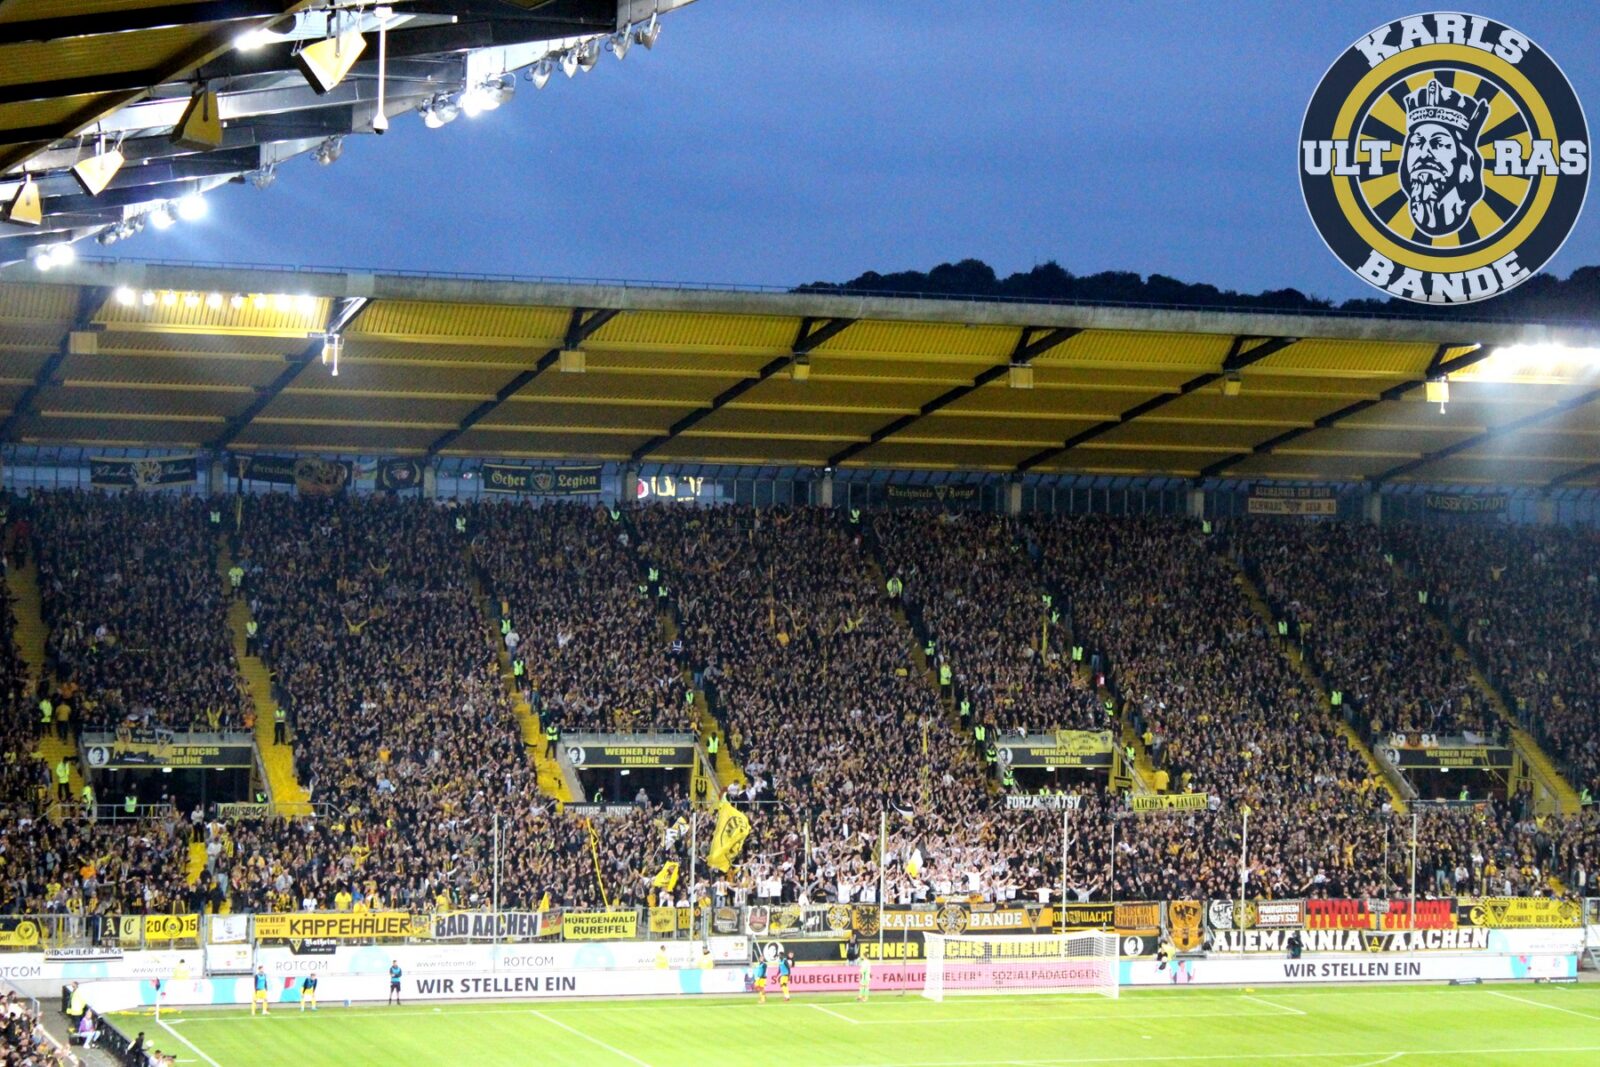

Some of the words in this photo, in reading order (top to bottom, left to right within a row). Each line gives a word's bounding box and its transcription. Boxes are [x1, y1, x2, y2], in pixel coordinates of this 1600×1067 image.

[491, 469, 527, 488] Öcher
[557, 473, 597, 488] Legion
[1425, 494, 1462, 510] KAISER
[1471, 495, 1506, 510] STADT
[186, 747, 220, 756] FUCHS
[604, 747, 646, 756] WERNER
[645, 747, 676, 756] FUCHS
[1425, 749, 1460, 758] WERNER
[620, 755, 661, 764] TRIBÜNE
[1045, 756, 1082, 764] TRIBÜNE
[1440, 757, 1474, 765] TRIBÜNE
[1006, 795, 1039, 810] FORZA
[1054, 795, 1081, 810] ATSV
[564, 914, 636, 925] HÜRTGENWALD
[881, 913, 935, 929] KARLS
[969, 911, 1023, 927] BANDE
[1080, 910, 1113, 923] WACHT
[1308, 898, 1371, 929] TIVOLI
[103, 917, 116, 936] A
[146, 920, 162, 933] 20
[184, 919, 197, 932] 15
[288, 912, 411, 936] KAPPEHÄUER
[436, 914, 469, 937] BAD
[472, 913, 538, 937] AACHEN
[572, 925, 628, 935] RUREIFEL
[1213, 930, 1363, 951] ALEMANNIA
[1389, 929, 1489, 950] AACHEN
[276, 960, 328, 971] ROTCOM
[416, 959, 477, 968] www.rotcom.de
[503, 956, 554, 967] ROTCOM
[1284, 963, 1316, 978] WIR
[1321, 963, 1389, 977] STELLEN
[1394, 962, 1421, 976] EIN
[416, 978, 455, 994] WIR
[460, 977, 539, 993] STELLEN
[545, 976, 576, 991] EIN
